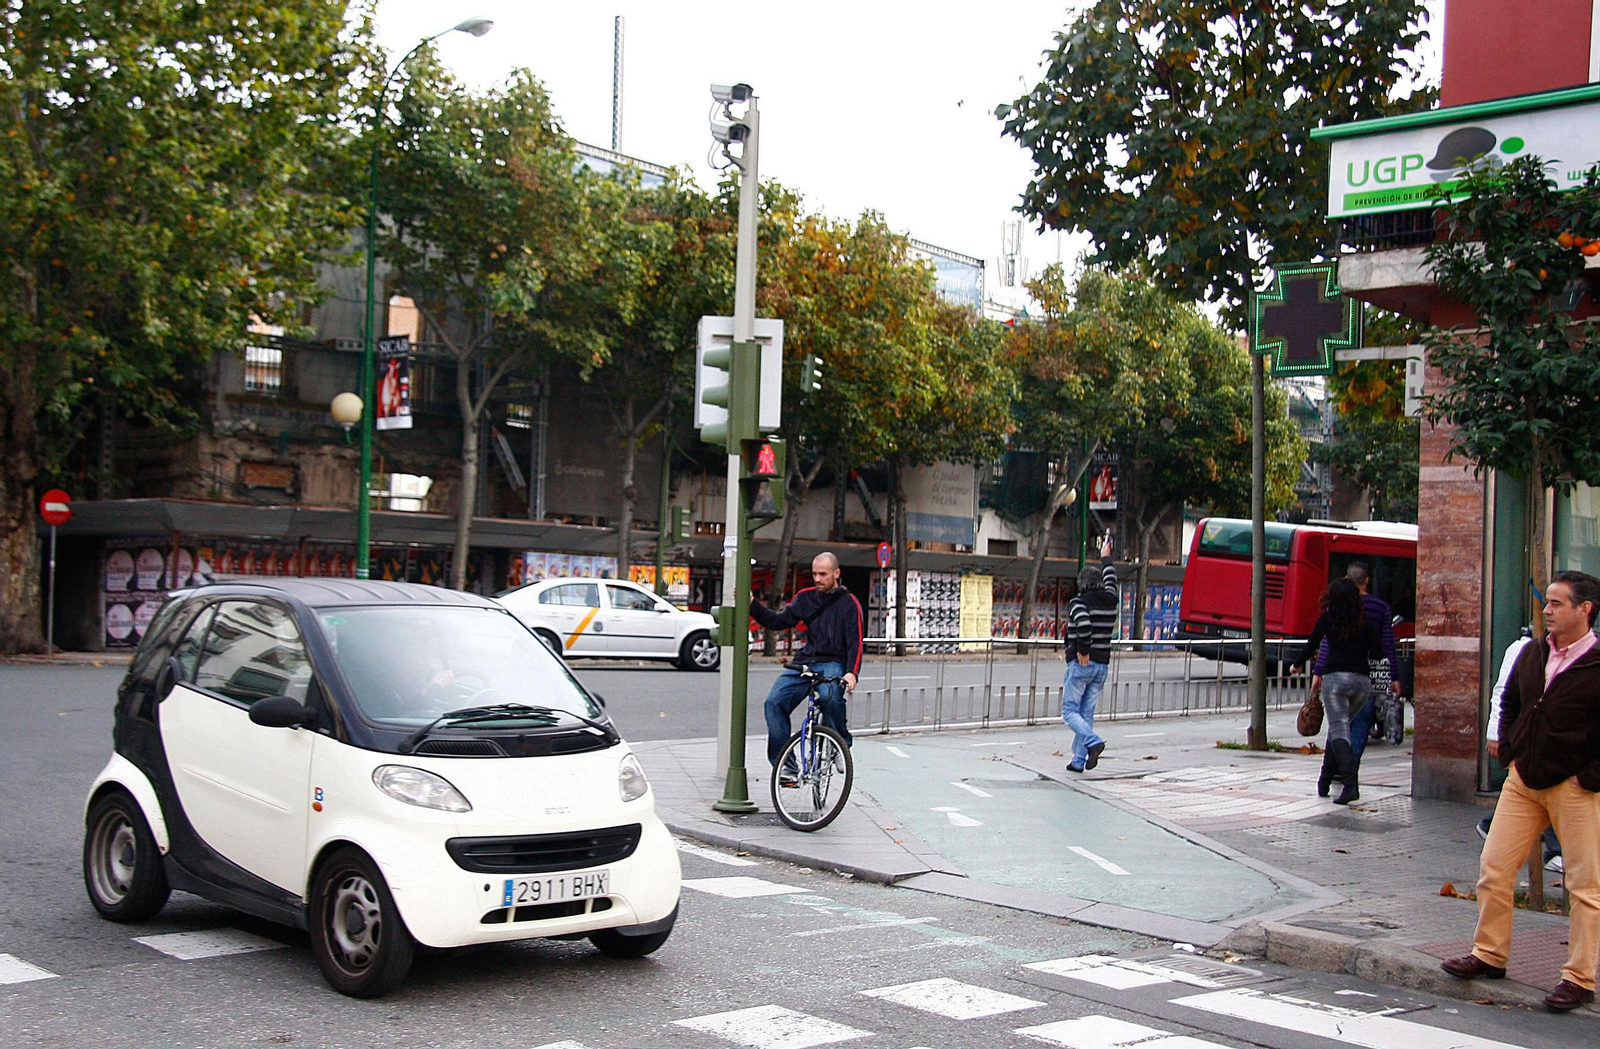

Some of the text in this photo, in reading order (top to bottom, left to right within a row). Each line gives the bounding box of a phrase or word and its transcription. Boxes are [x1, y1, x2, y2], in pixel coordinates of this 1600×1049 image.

[1346, 154, 1424, 187] UGP
[1354, 193, 1401, 206] PREVENCIÓN
[1403, 192, 1412, 201] DE
[378, 338, 409, 353] SICAB
[517, 873, 607, 903] 2911 BHX
